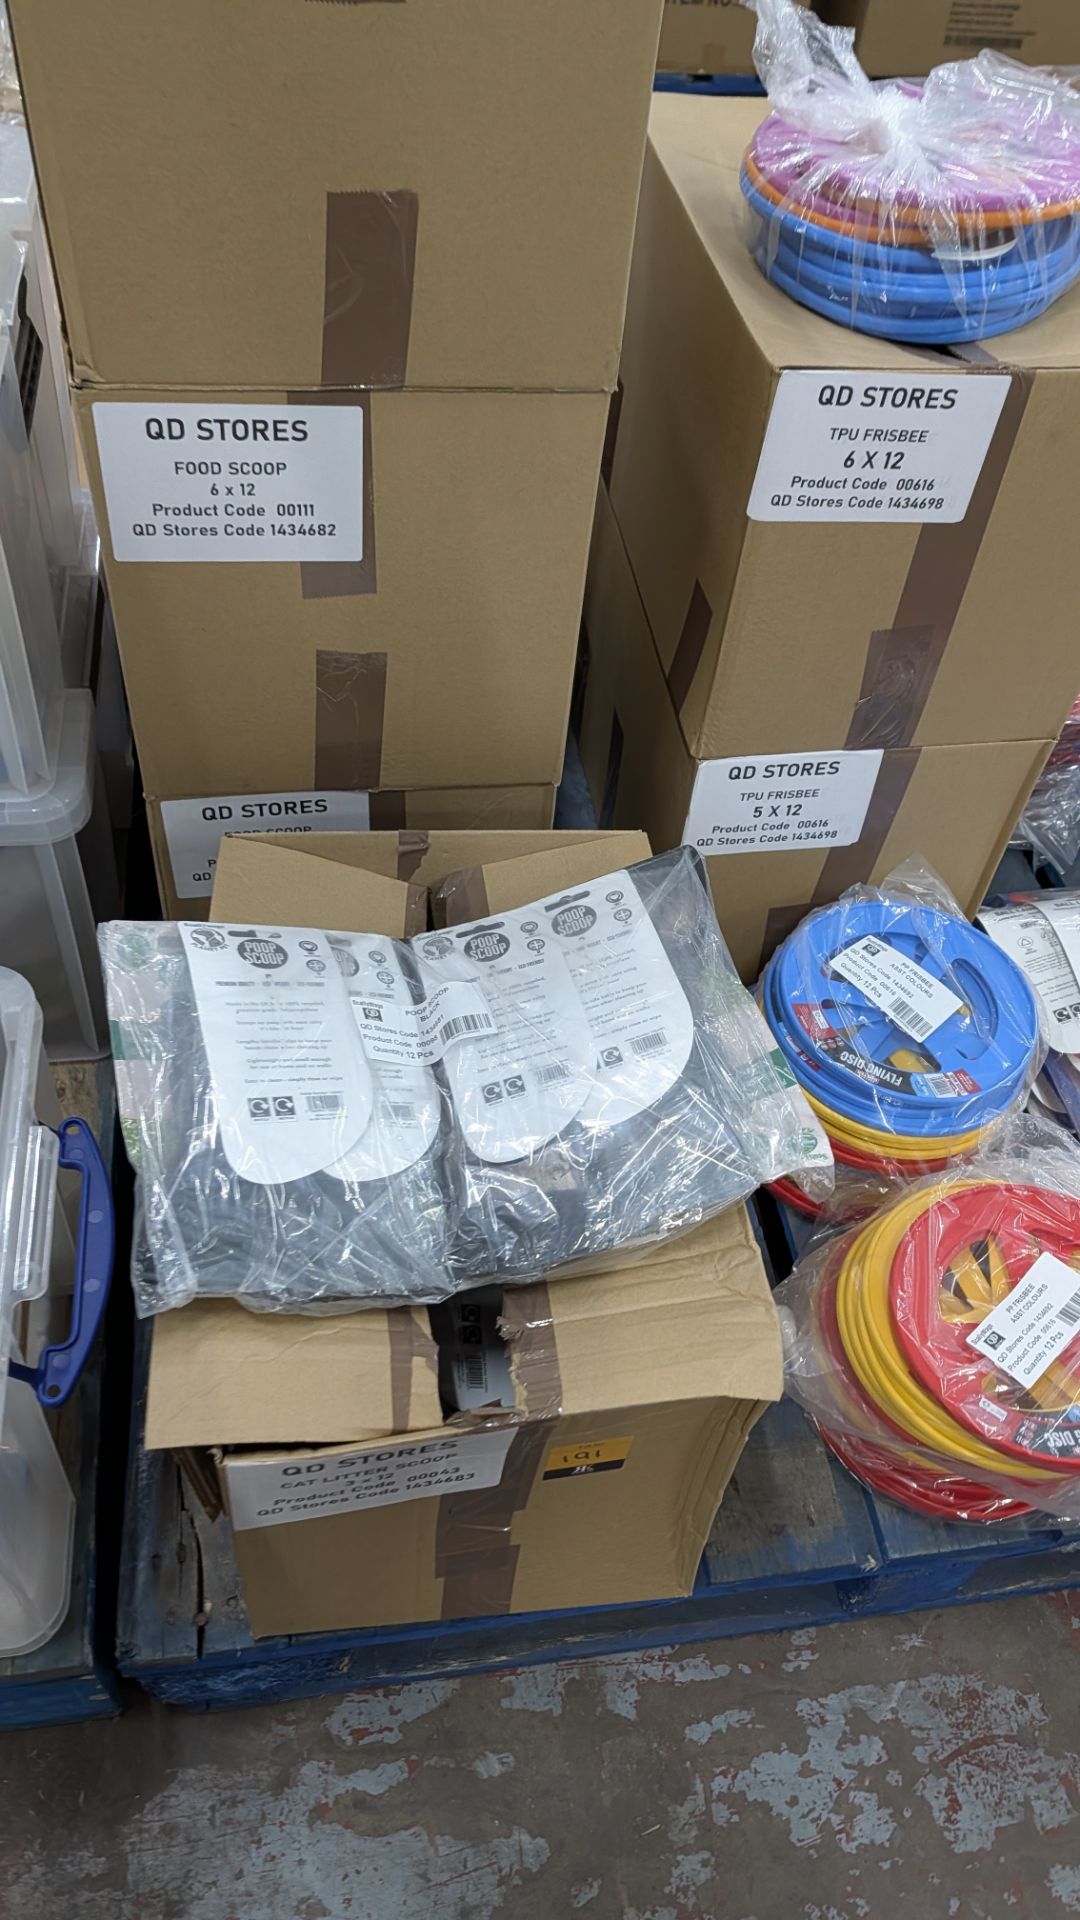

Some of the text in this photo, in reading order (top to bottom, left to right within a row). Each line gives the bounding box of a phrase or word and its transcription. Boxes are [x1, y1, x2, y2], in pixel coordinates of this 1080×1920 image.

[818, 385, 958, 410] QD STORES
[145, 418, 309, 442] QD STORES
[830, 427, 929, 443] TPU FRISBEE
[174, 462, 287, 475] FOOD SCOOP
[843, 451, 905, 470] 6 X 12
[210, 483, 256, 496] 6 x 12
[791, 476, 935, 491] Product Code 00616
[152, 503, 315, 517] Product Code 00111
[771, 494, 944, 510] QD Stores Code 1434698
[133, 524, 337, 537] QD Stores Code 1434682
[728, 761, 840, 780] QD STORES
[740, 789, 820, 801] TPU FRISBEE
[202, 799, 328, 821] QD STORES
[753, 806, 763, 818] 5
[785, 804, 802, 816] 12
[712, 819, 829, 834] Product Code 00616
[697, 830, 837, 847] QD Stores Code 1434698
[192, 872, 212, 882] QD
[557, 906, 586, 924] POOP
[557, 915, 594, 936] SCOOP
[244, 941, 277, 954] POOP
[470, 933, 500, 950] POOP
[243, 952, 285, 965] SCOOP
[469, 942, 507, 961] SCOOP
[405, 1006, 427, 1016] POOP
[406, 1051, 416, 1059] 12
[865, 1062, 903, 1087] FLYING
[1012, 1283, 1036, 1308] FRISBEE
[1022, 1283, 1049, 1312] COLOURS
[1023, 1332, 1064, 1376] Quantity 12 Pcs
[282, 1440, 458, 1477] QD STORES
[280, 1453, 458, 1489] CAT LITTER SCOOP
[378, 1473, 395, 1481] 12
[257, 1507, 283, 1517] QD
[290, 1497, 350, 1512] Stores
[356, 1487, 400, 1500] Code
[273, 1490, 345, 1506] Product
[351, 1481, 396, 1493] Code
